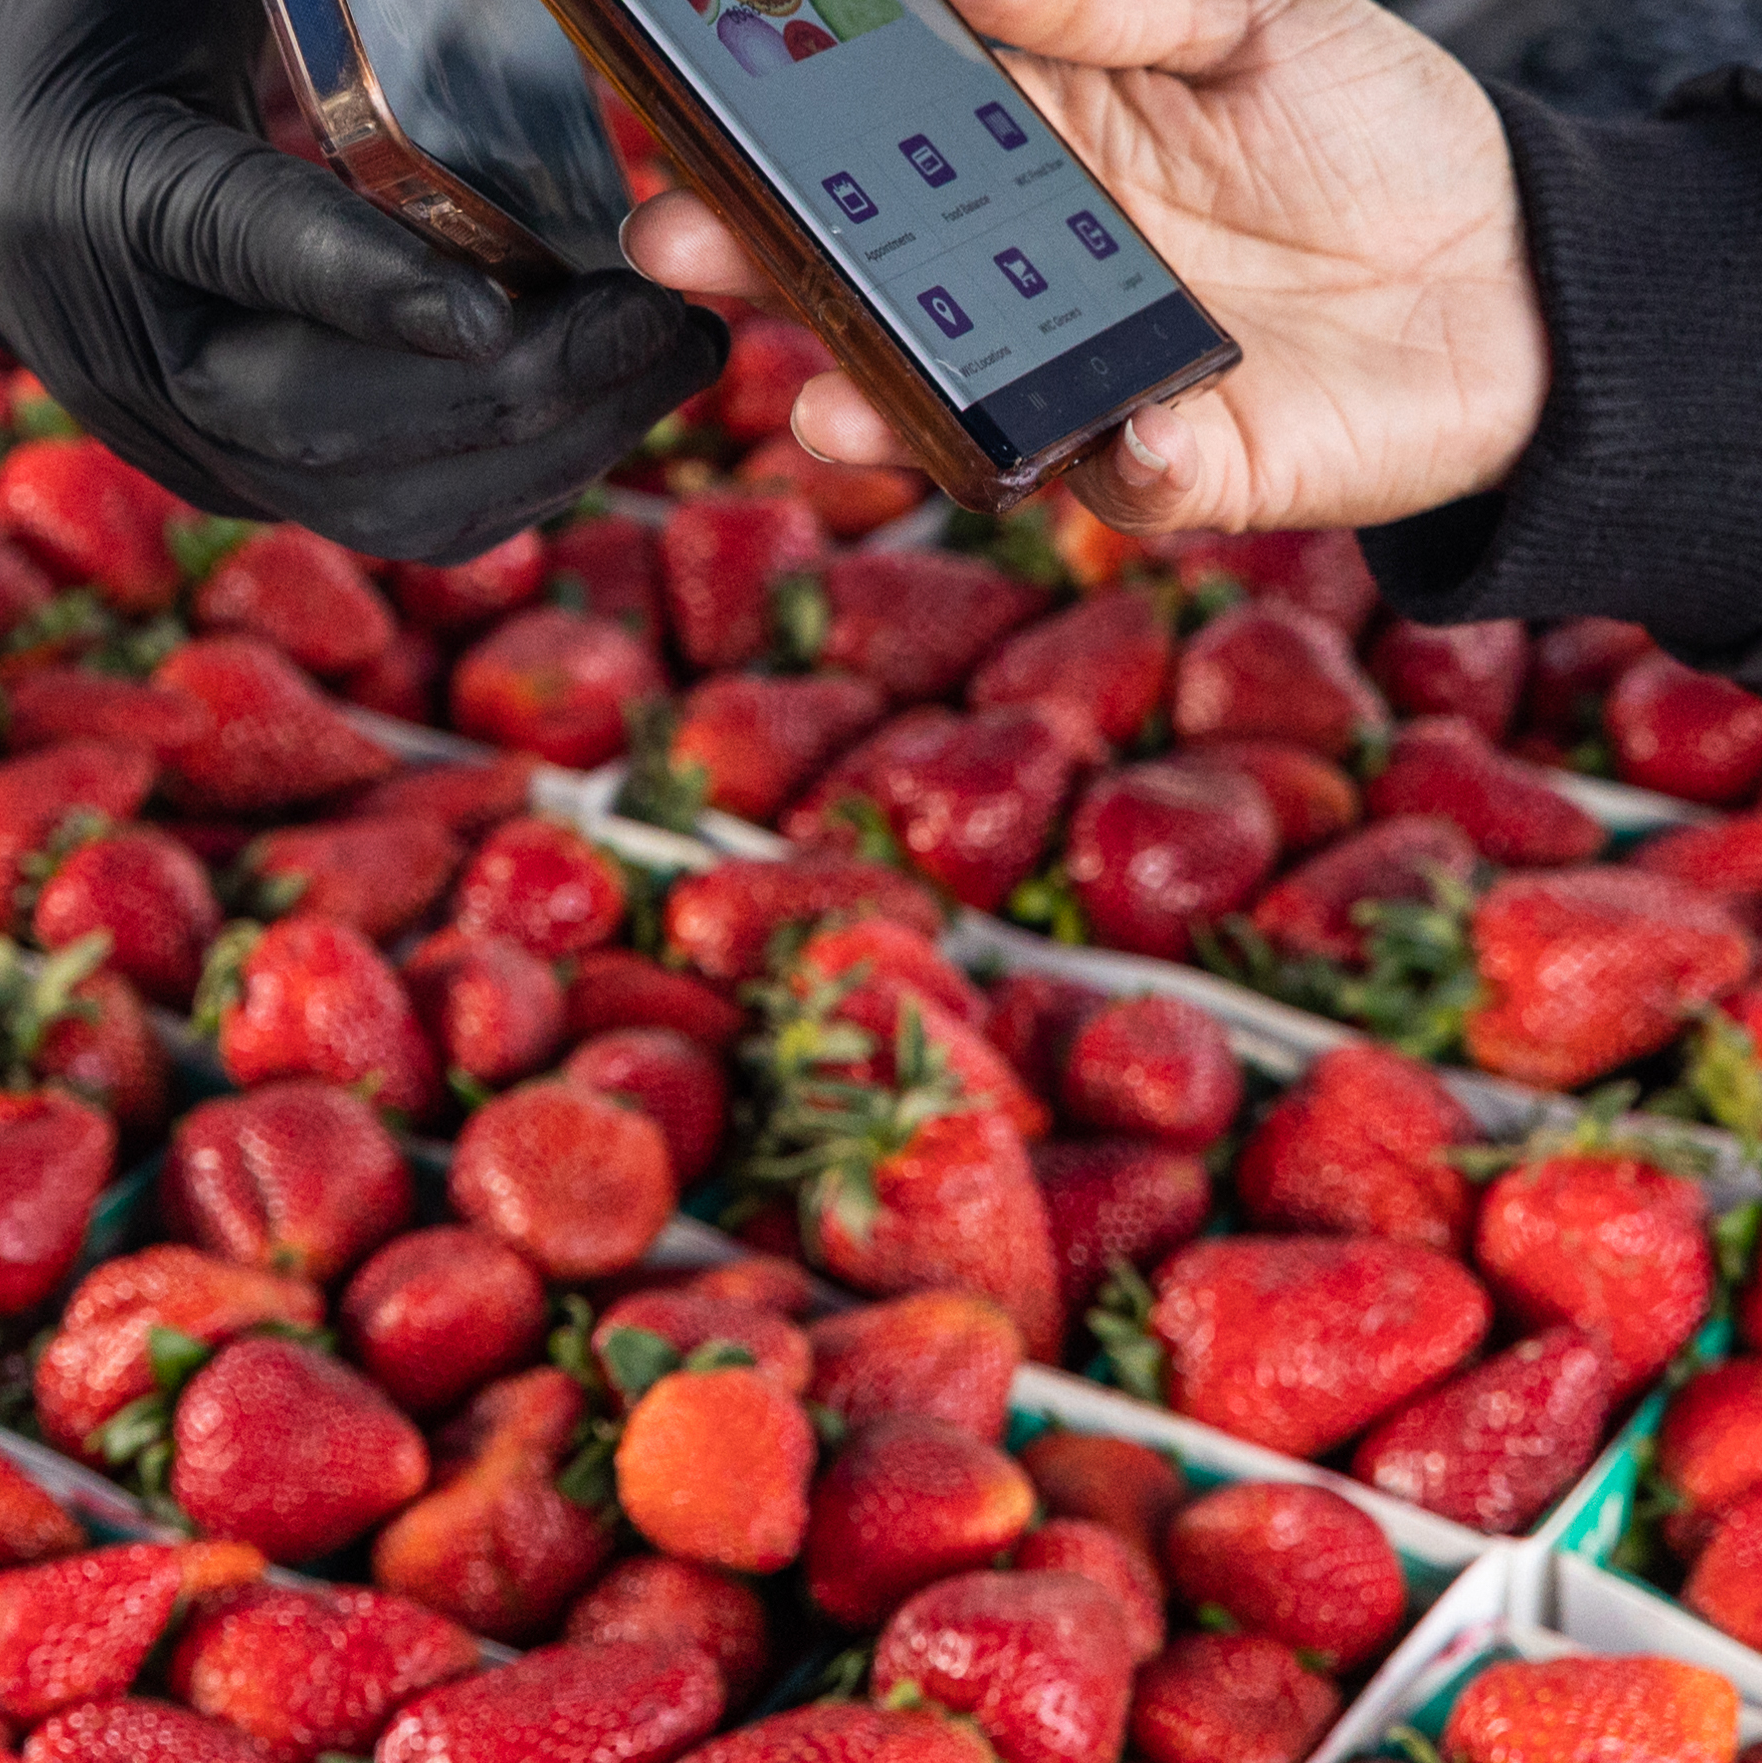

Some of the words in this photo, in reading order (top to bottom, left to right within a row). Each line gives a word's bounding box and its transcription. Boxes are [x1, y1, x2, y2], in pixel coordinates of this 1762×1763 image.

[941, 206, 965, 223] Food
[960, 194, 992, 215] Balance
[864, 231, 917, 262] Appointments
[1038, 320, 1057, 336] WIC
[975, 344, 1012, 372] Locations
